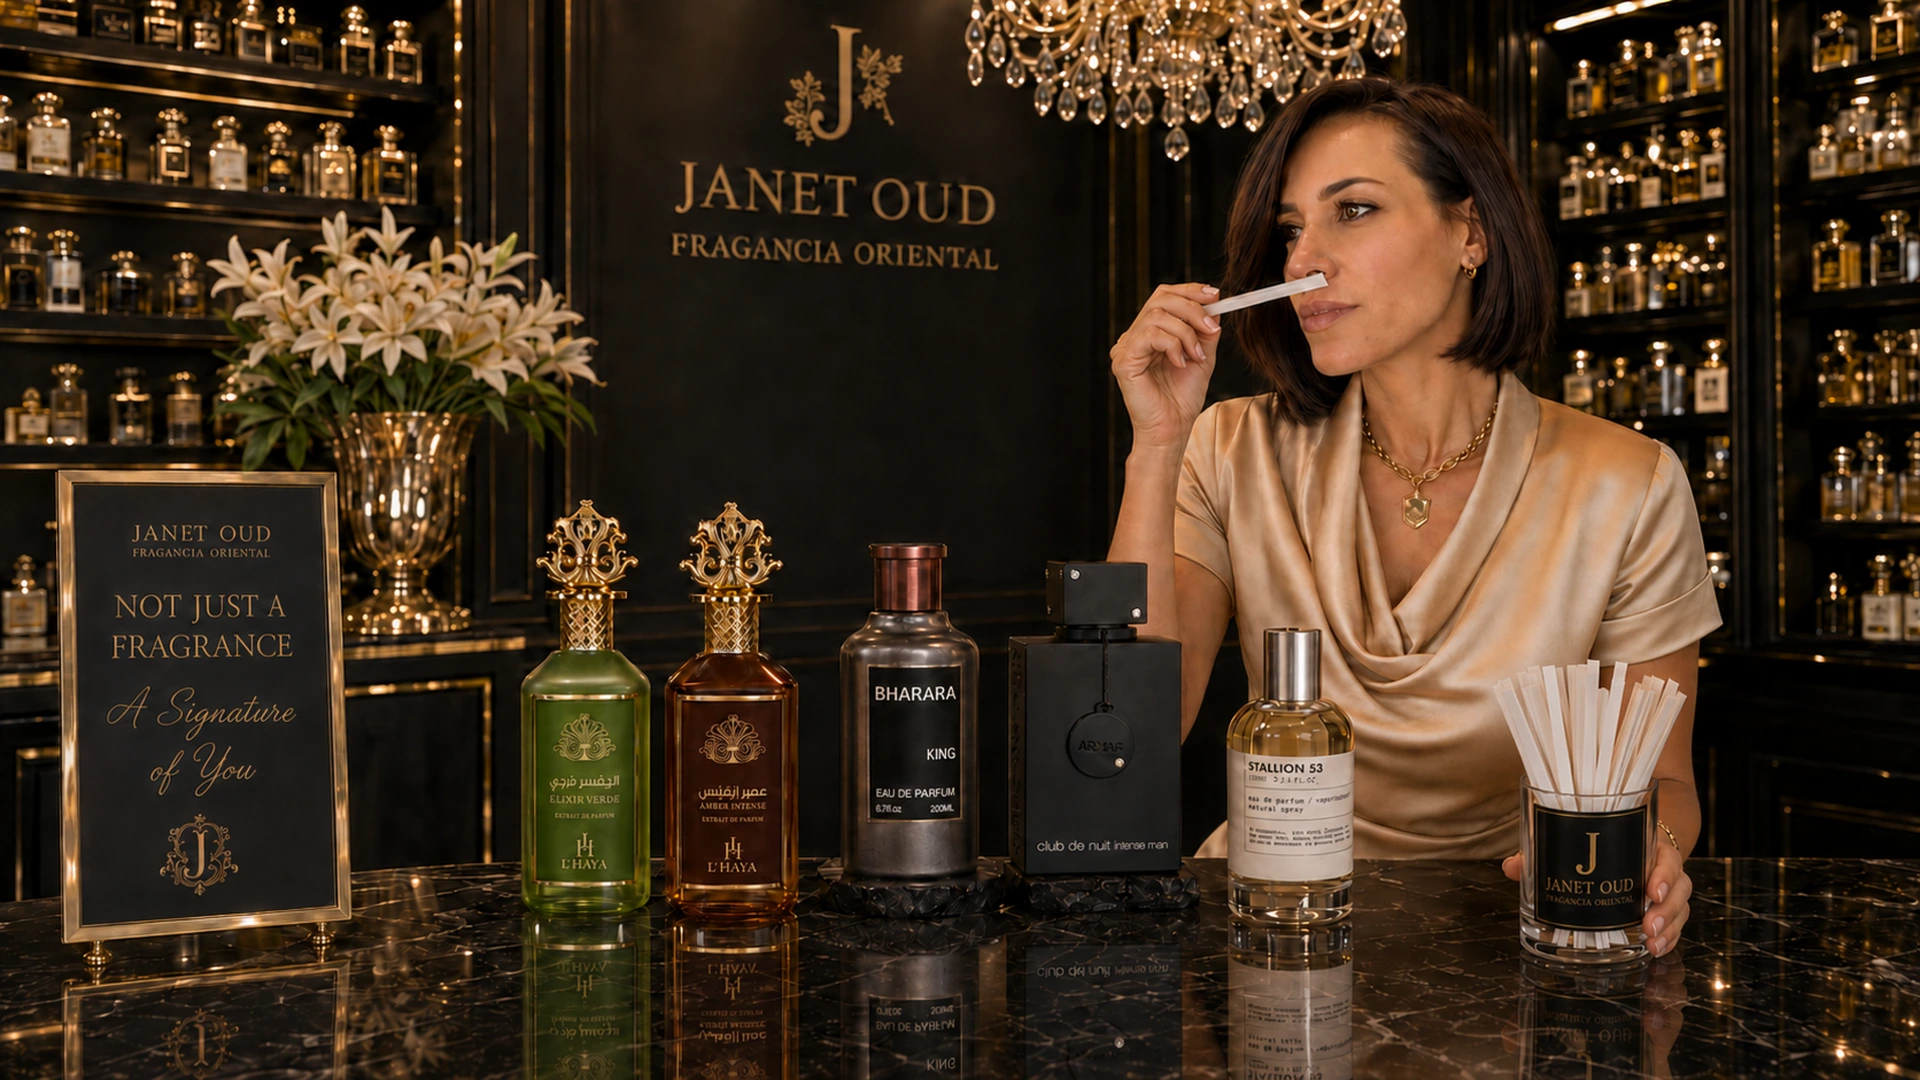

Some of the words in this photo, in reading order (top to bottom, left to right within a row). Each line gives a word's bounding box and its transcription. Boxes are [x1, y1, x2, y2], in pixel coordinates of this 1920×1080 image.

[674, 160, 857, 218] JANET
[871, 178, 997, 226] OUD
[671, 233, 843, 264] FRAGANCIA
[853, 242, 999, 271] ORIENTAL
[131, 523, 209, 543] JANET
[219, 524, 272, 543] OUD
[132, 547, 204, 558] FRAGANCIA
[209, 547, 271, 558] ORIENTAL
[114, 594, 182, 619] NOT
[191, 594, 259, 625] JUST
[267, 594, 286, 618] A
[111, 633, 293, 660] FRAGRANCE
[875, 686, 957, 702] BHARARA
[106, 686, 151, 730] A
[156, 686, 297, 741] Signature
[926, 747, 957, 761] KING
[150, 750, 185, 796] of
[193, 741, 257, 797] You
[1248, 761, 1305, 774] STALLION
[1309, 763, 1324, 774] 53
[549, 794, 585, 804] ELIXIR
[586, 794, 620, 804] VERDE
[875, 787, 896, 799] EAU
[898, 788, 912, 799] DE
[914, 787, 956, 799] PARFUM
[699, 801, 729, 810] AMBER
[731, 801, 767, 810] INTENSE
[1036, 840, 1065, 852] club
[1068, 840, 1086, 852] de
[1088, 840, 1112, 851] nuit
[1114, 840, 1146, 851] intense
[1575, 832, 1601, 876] J
[707, 861, 757, 873] L'HAYA
[1545, 877, 1595, 894] JANET
[1600, 878, 1634, 894] OUD
